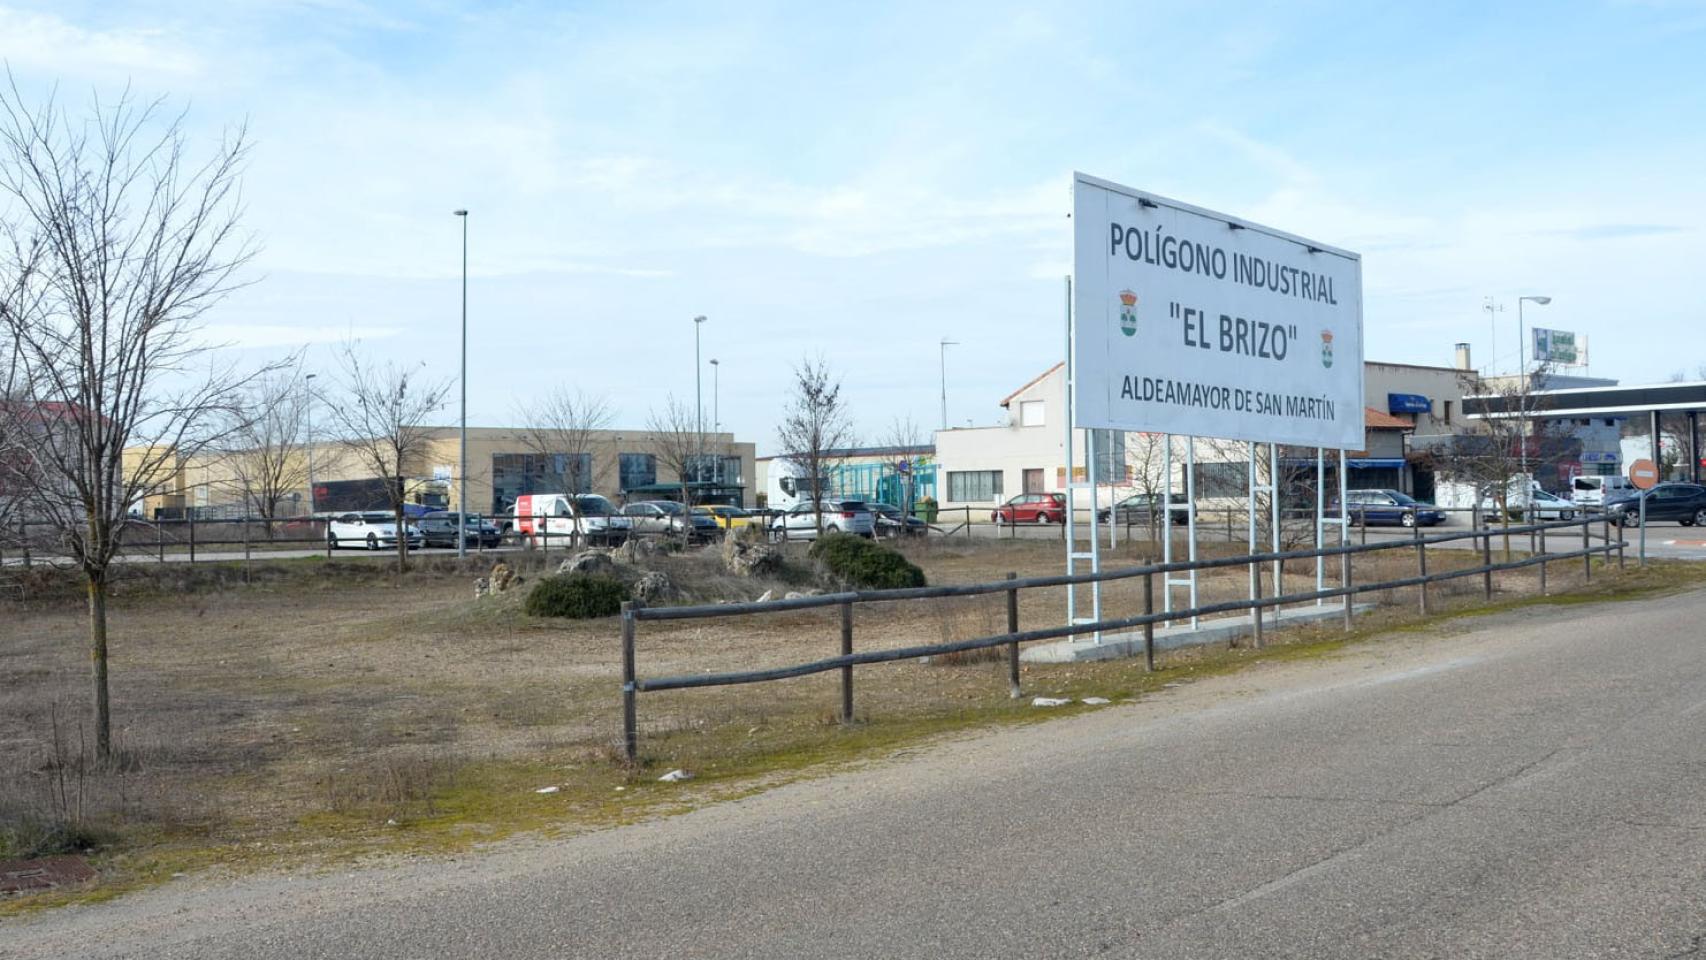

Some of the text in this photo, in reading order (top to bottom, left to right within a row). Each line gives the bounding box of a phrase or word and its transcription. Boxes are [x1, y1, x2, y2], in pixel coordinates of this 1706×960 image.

[1110, 222, 1338, 305] POLÍGONO INDUSTRIAL
[1170, 302, 1297, 361] "EL BRIZO"
[1121, 375, 1335, 420] ALDEAMAYOR DE SAN MARTÍN
